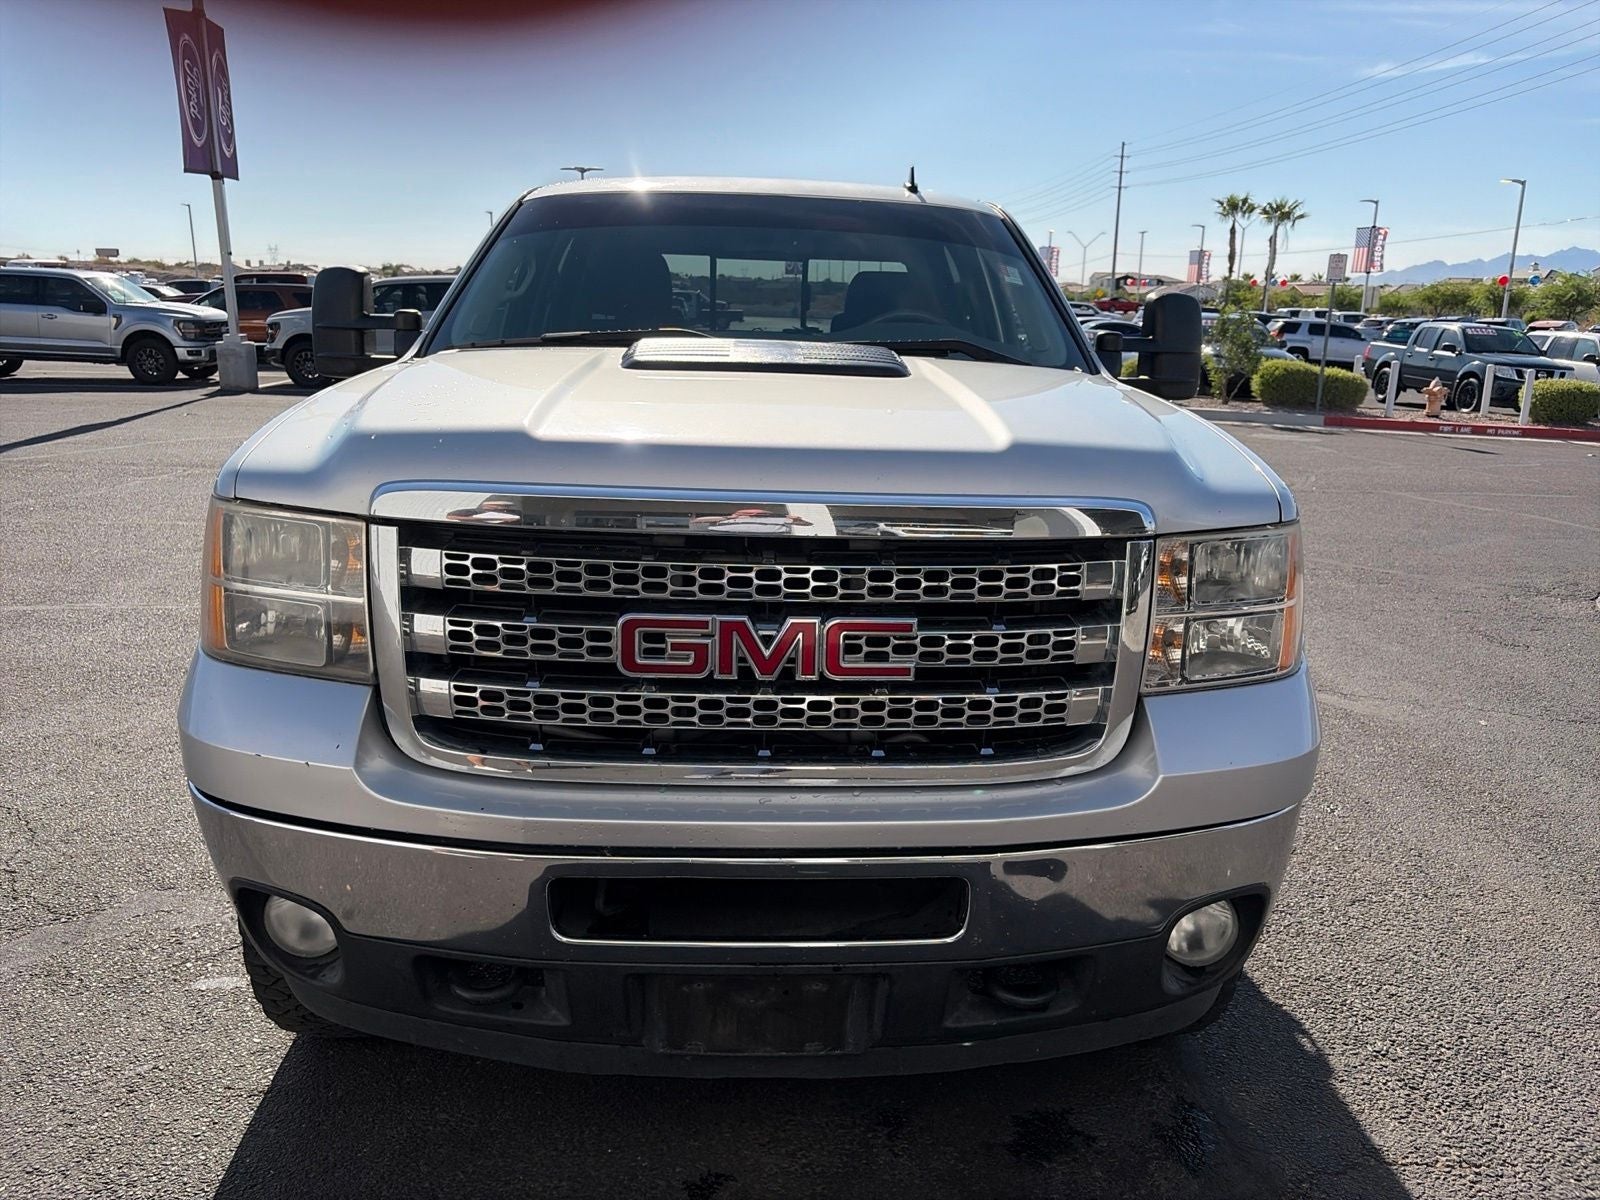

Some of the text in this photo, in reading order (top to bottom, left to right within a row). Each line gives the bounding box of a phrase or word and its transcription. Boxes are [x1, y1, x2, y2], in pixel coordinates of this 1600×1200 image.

[184, 59, 202, 120] Ford
[217, 76, 232, 134] Ford
[616, 613, 918, 681] GMC
